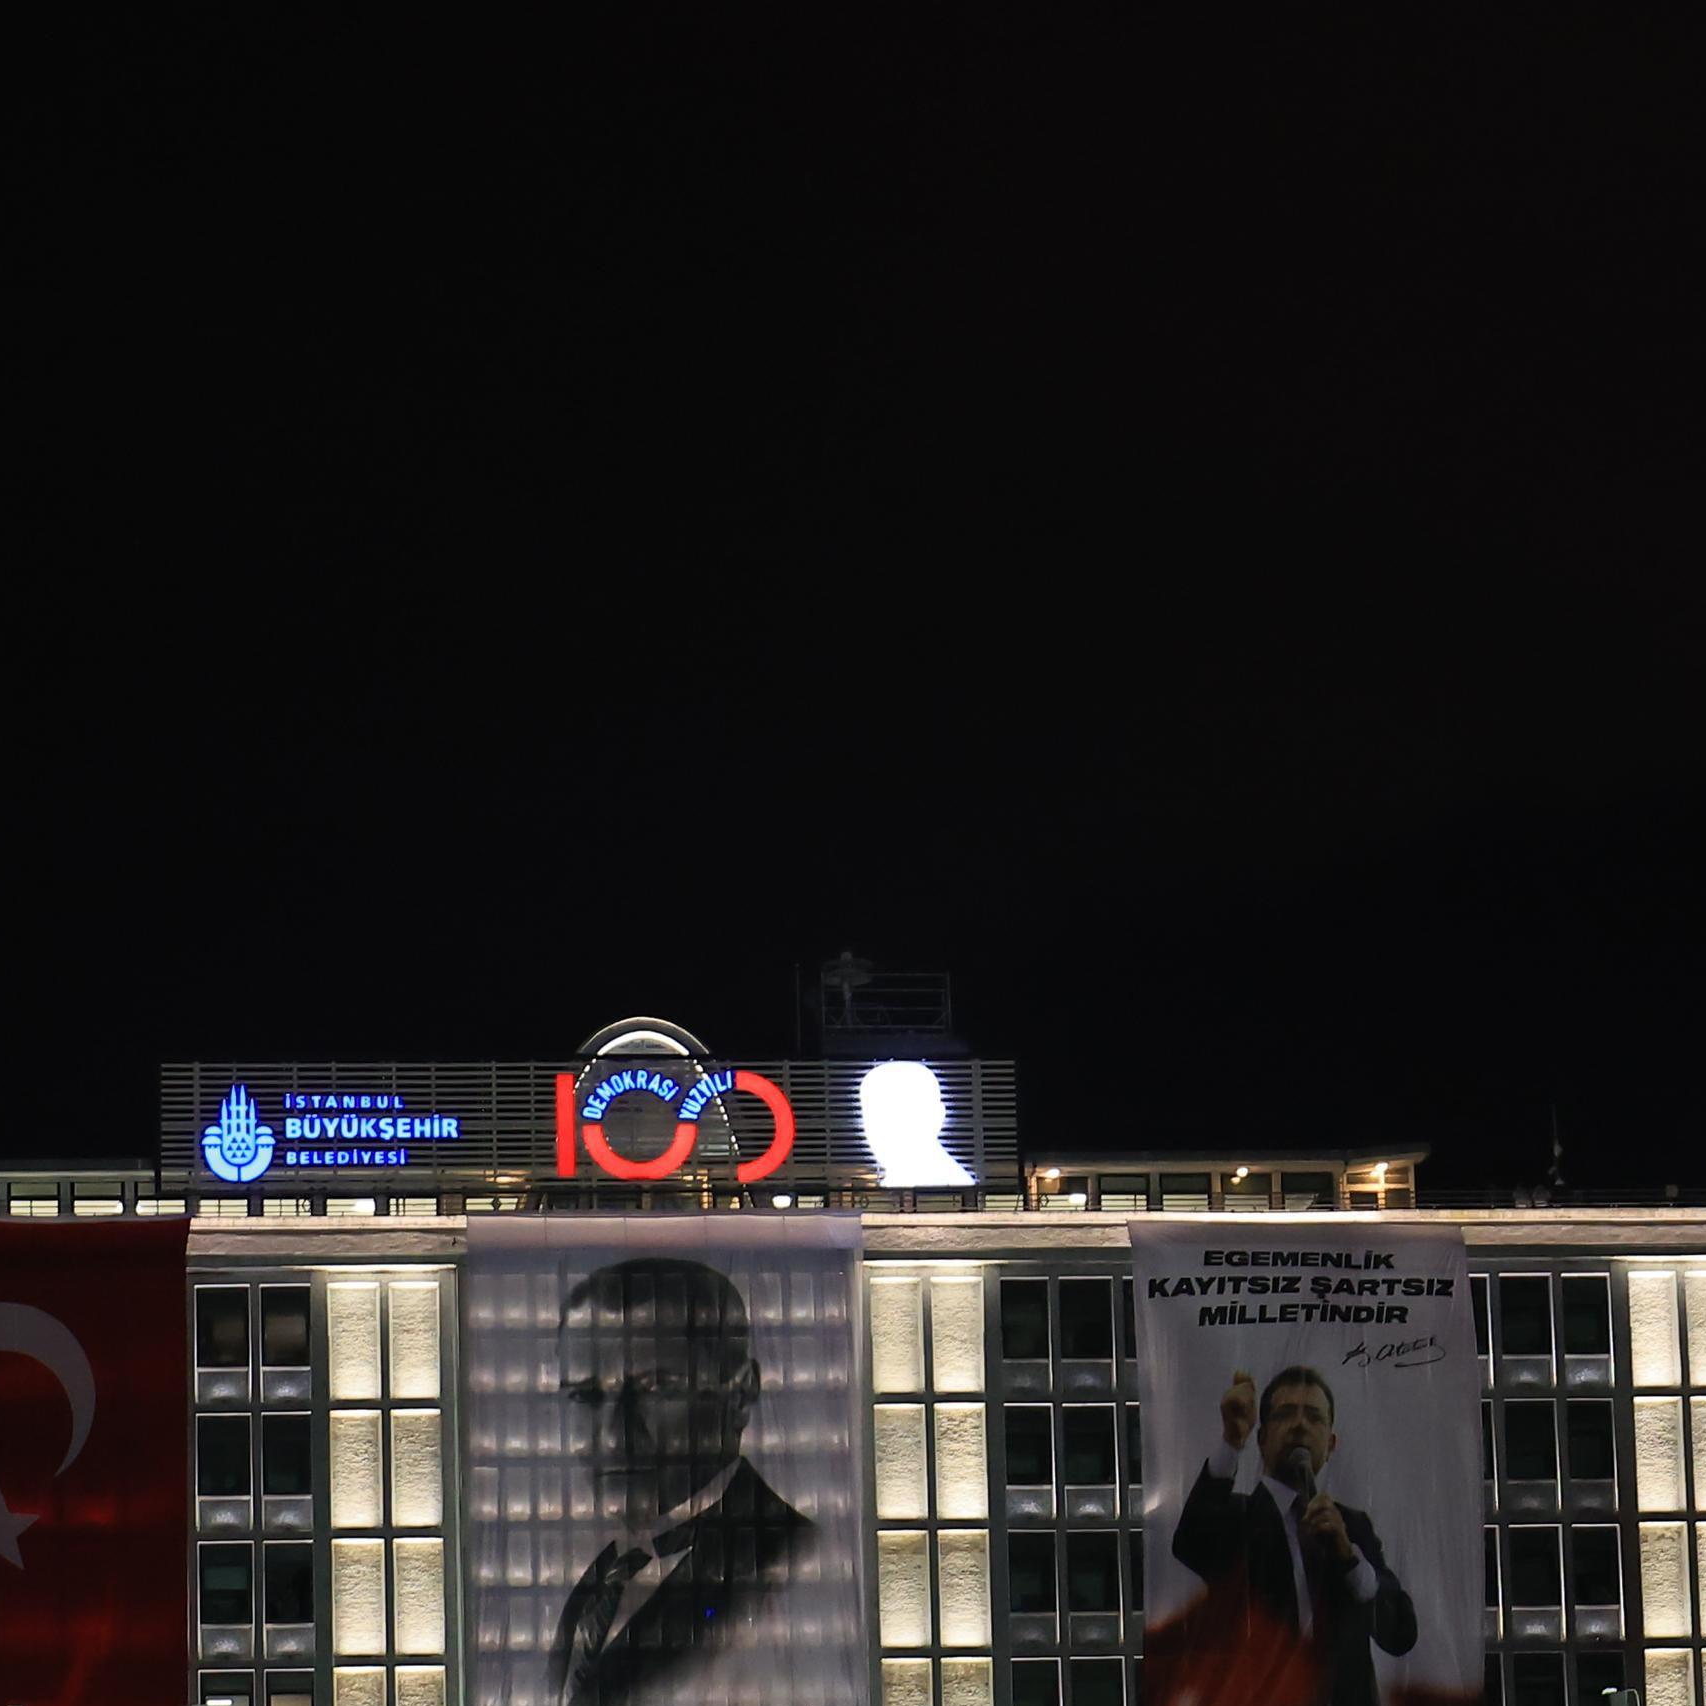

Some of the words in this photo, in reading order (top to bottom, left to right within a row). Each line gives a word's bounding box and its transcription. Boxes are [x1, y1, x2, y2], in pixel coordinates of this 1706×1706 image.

[285, 1093, 405, 1109] İSTANBUL
[582, 1069, 680, 1120] DEMOKRASİ
[285, 1114, 459, 1140] BÜYÜKŞEHİR
[286, 1148, 406, 1165] BELEDİYESİ
[1203, 1249, 1396, 1270] EGEMENLİK
[1147, 1275, 1300, 1299] KAYITSIZ
[1309, 1275, 1455, 1299] ŞARTSIZ
[1197, 1299, 1409, 1327] MİLLETİNDİR
